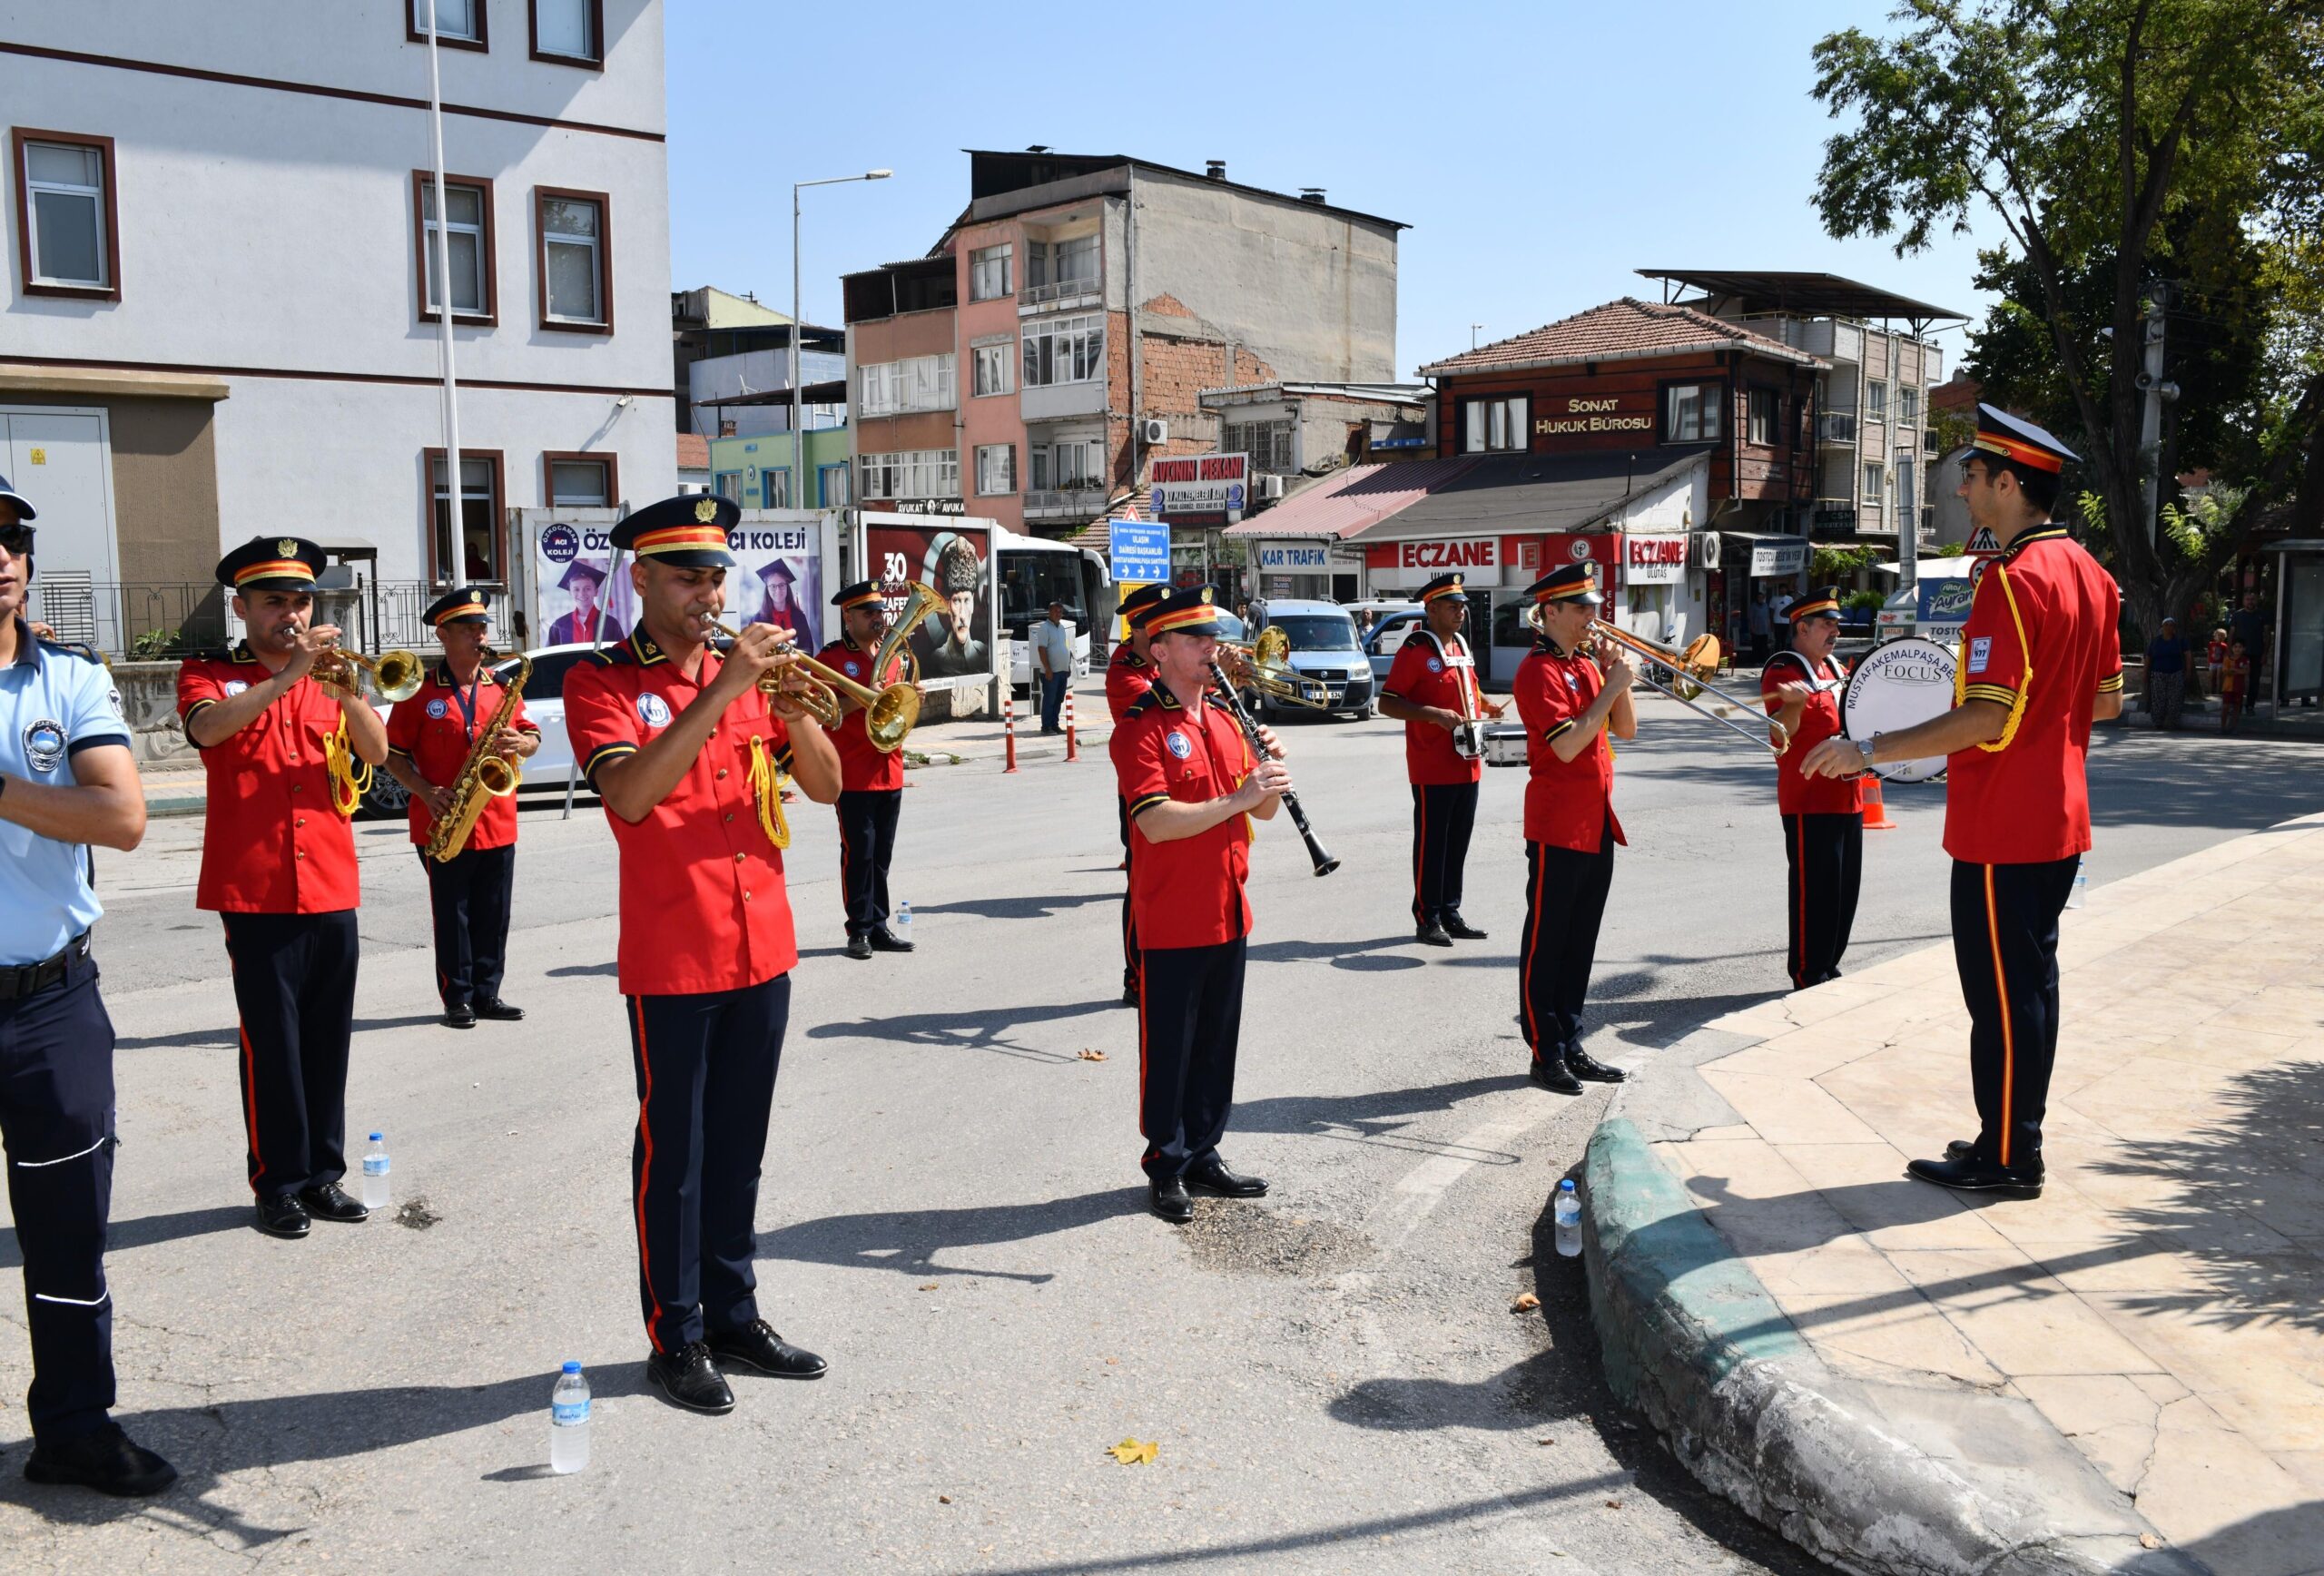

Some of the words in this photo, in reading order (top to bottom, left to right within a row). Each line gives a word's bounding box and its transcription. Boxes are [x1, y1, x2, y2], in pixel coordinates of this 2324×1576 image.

[1569, 399, 1619, 413] SONAT
[1536, 419, 1588, 434] HUKUK
[1590, 417, 1652, 431] BÜROSU
[1152, 460, 1196, 483] AVCININ
[1199, 457, 1244, 480] MEKANI
[898, 503, 923, 514] AVUKAT
[725, 532, 745, 551] ÇI
[752, 527, 806, 550] KOLEJİ
[1262, 549, 1284, 566] KAR
[1403, 541, 1493, 567] ECZANE
[1630, 540, 1683, 564] ECZANE
[884, 553, 907, 582] 30
[1935, 590, 1974, 611] Ayran
[1847, 649, 1940, 709] MUSTAFAKEMALPAŞA
[1884, 664, 1943, 681] FOCUS
